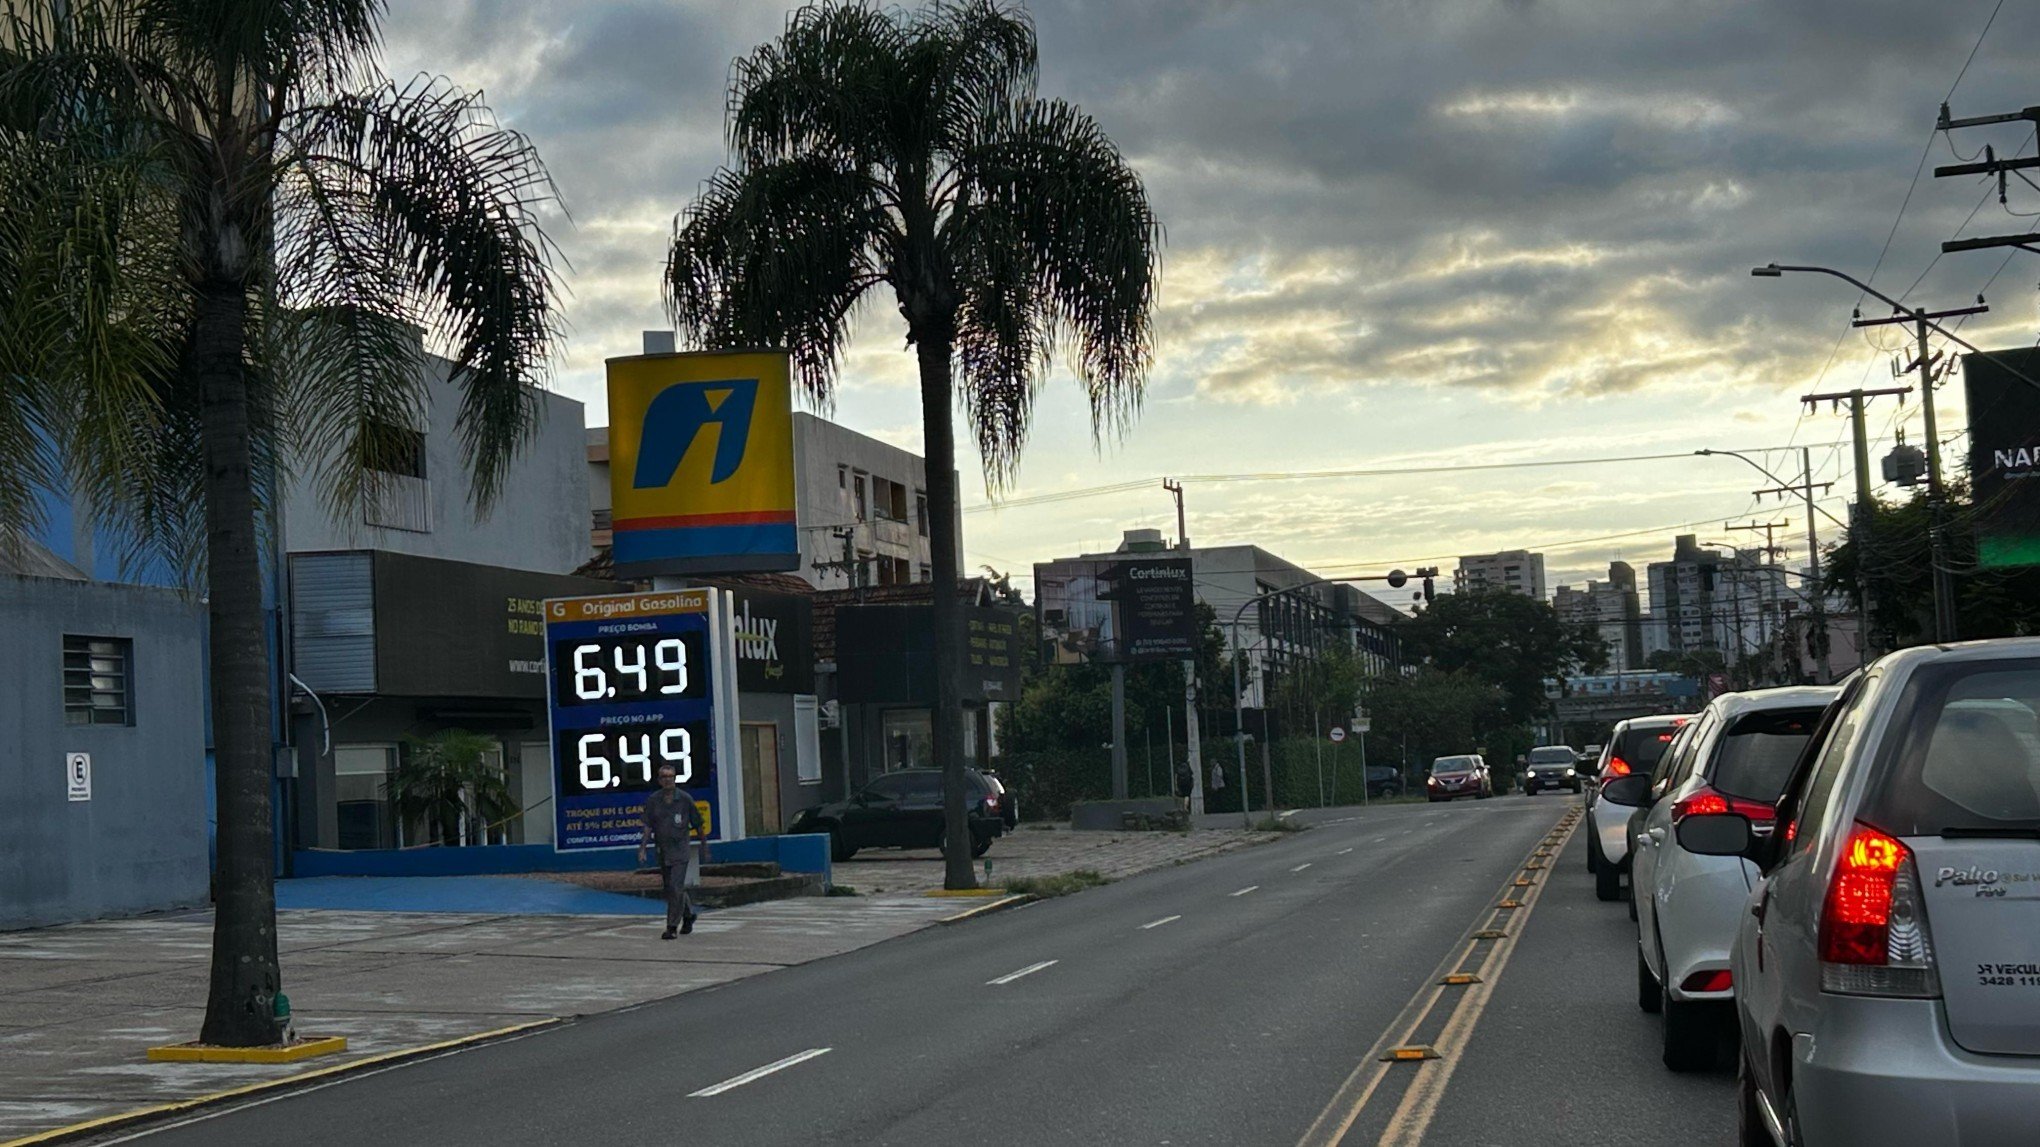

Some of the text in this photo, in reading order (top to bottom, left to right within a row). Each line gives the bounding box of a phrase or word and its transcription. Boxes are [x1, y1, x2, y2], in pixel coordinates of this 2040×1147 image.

[1129, 566, 1186, 580] Cortinlux
[517, 599, 535, 614] ANOS
[553, 596, 702, 617] G Original Gasolina
[507, 618, 518, 634] NO
[519, 619, 539, 636] RAMO
[598, 622, 658, 634] PREÇO BOMBA
[573, 638, 688, 700] 6,49
[600, 713, 664, 725] PREÇO NO APP
[578, 727, 692, 790] 6,49
[566, 809, 600, 818] TROQUE
[625, 805, 647, 814] GAN
[566, 821, 582, 831] ATÉ
[584, 821, 600, 830] 5%
[601, 820, 614, 828] DE
[566, 836, 598, 844] CONFIRA
[1935, 865, 1999, 887] Palio
[1979, 976, 2015, 986] 3428
